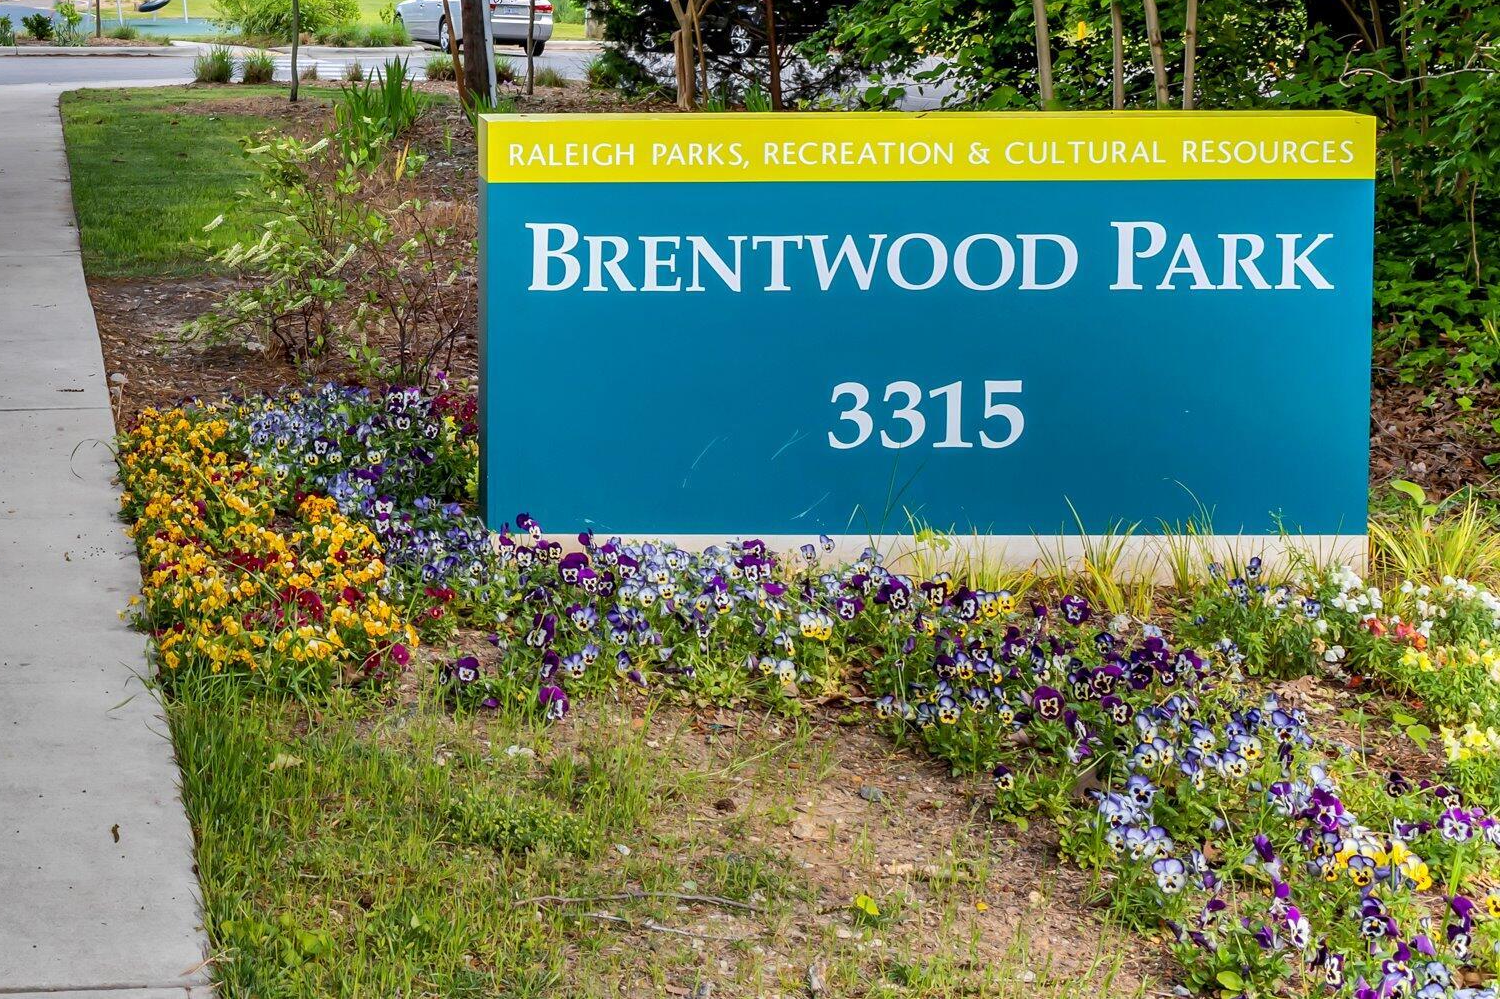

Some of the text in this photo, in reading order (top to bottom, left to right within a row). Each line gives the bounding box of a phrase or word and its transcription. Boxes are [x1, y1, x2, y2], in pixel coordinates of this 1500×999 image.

[508, 140, 1355, 170] RALEIGH PARKS, RECREATION & CULTURAL RESOURCES
[525, 221, 1336, 293] BRENTWOOD PARK
[826, 379, 1026, 451] 3315
